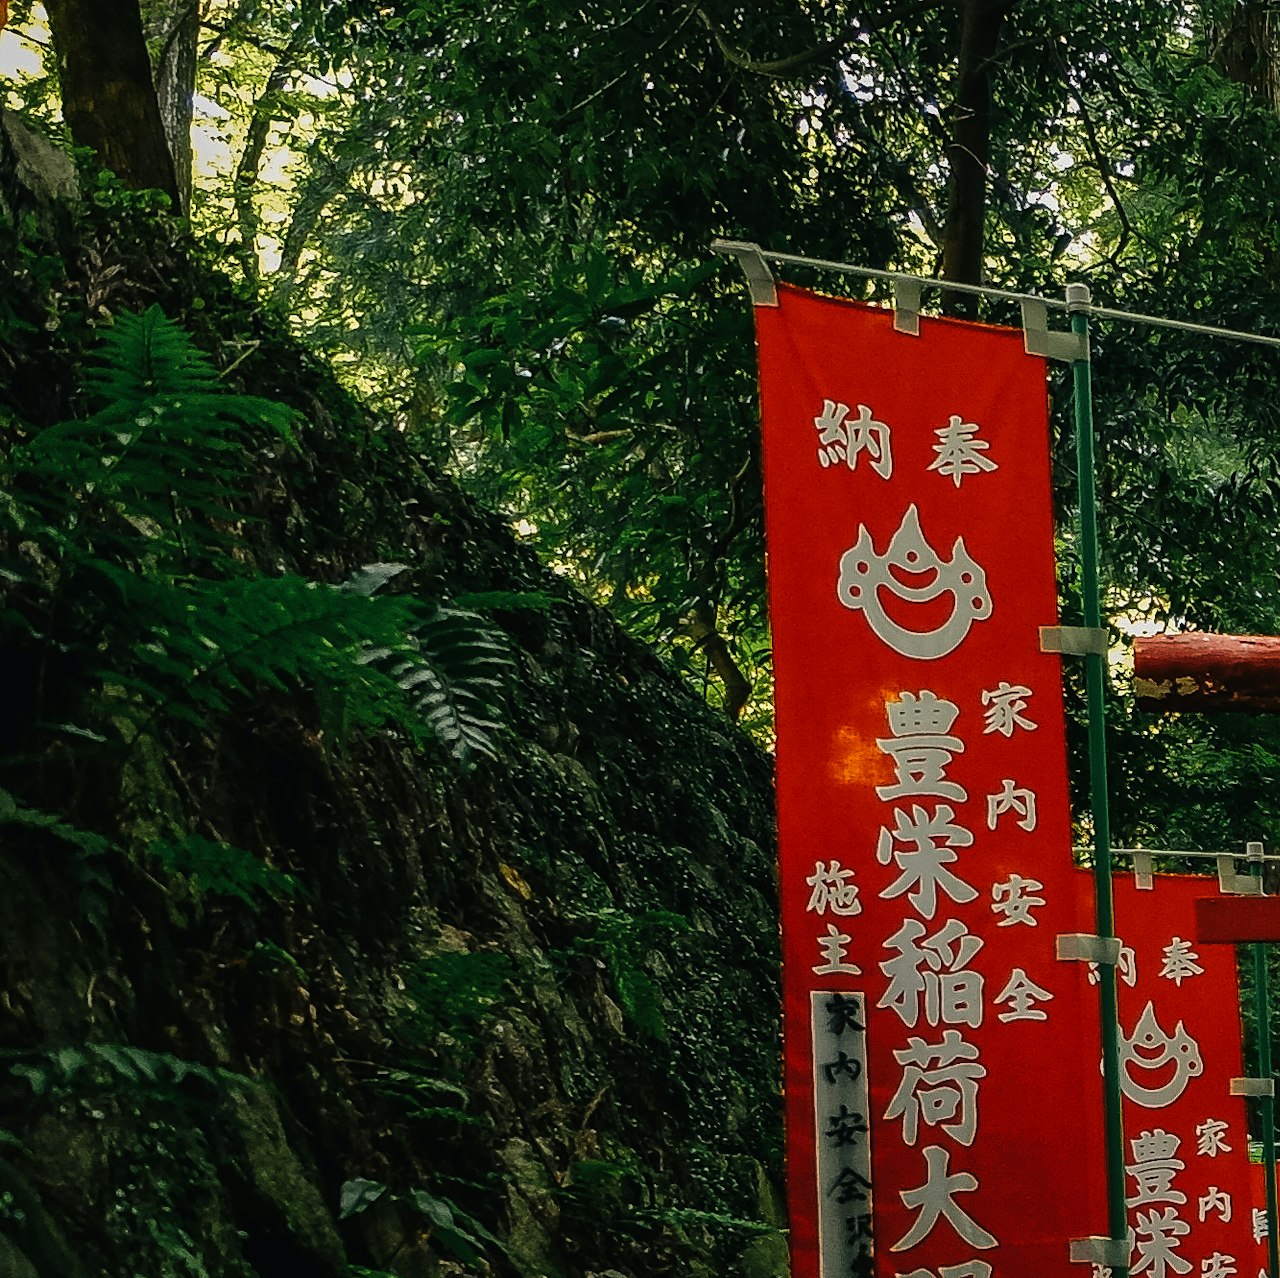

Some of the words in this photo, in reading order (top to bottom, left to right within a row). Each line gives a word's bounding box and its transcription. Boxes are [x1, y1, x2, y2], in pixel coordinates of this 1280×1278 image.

[806, 860, 862, 976] 施主
[980, 681, 1053, 1024] 家内安全
